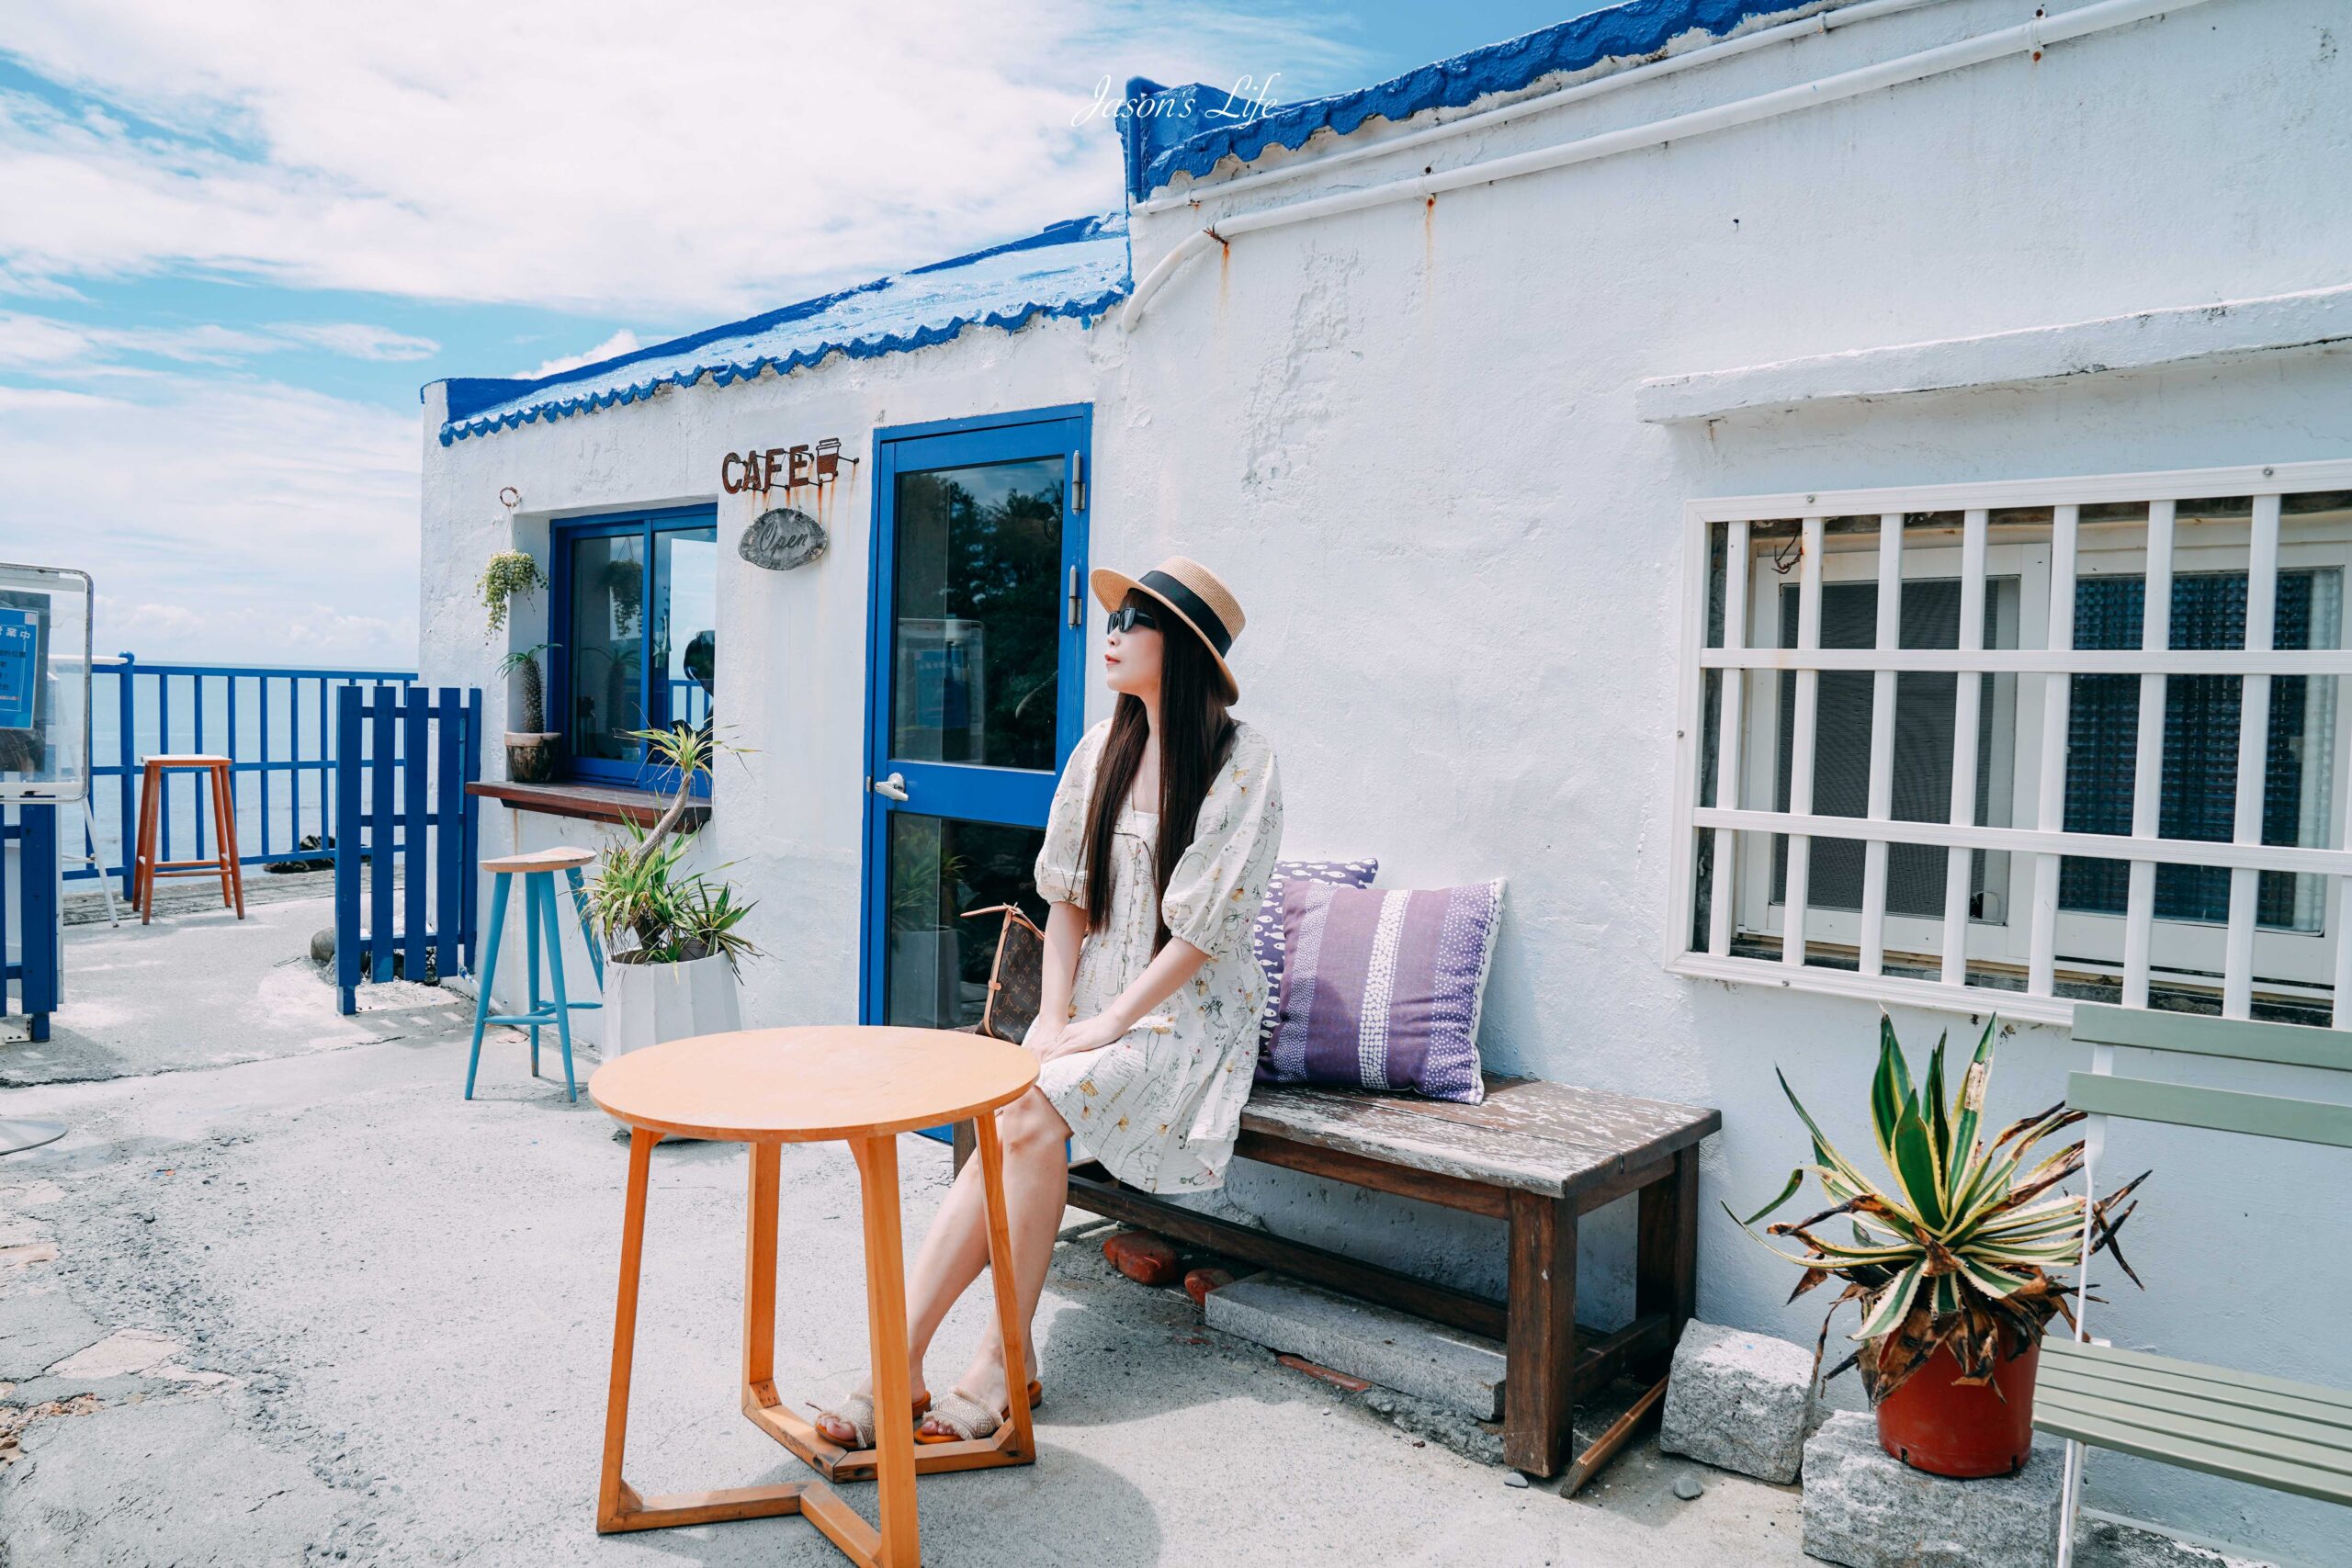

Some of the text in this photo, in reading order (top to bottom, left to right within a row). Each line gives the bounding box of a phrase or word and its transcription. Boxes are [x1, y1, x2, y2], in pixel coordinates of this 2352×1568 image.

[721, 444, 809, 495] CAFE
[759, 521, 808, 561] Open
[0, 626, 31, 640] 業中
